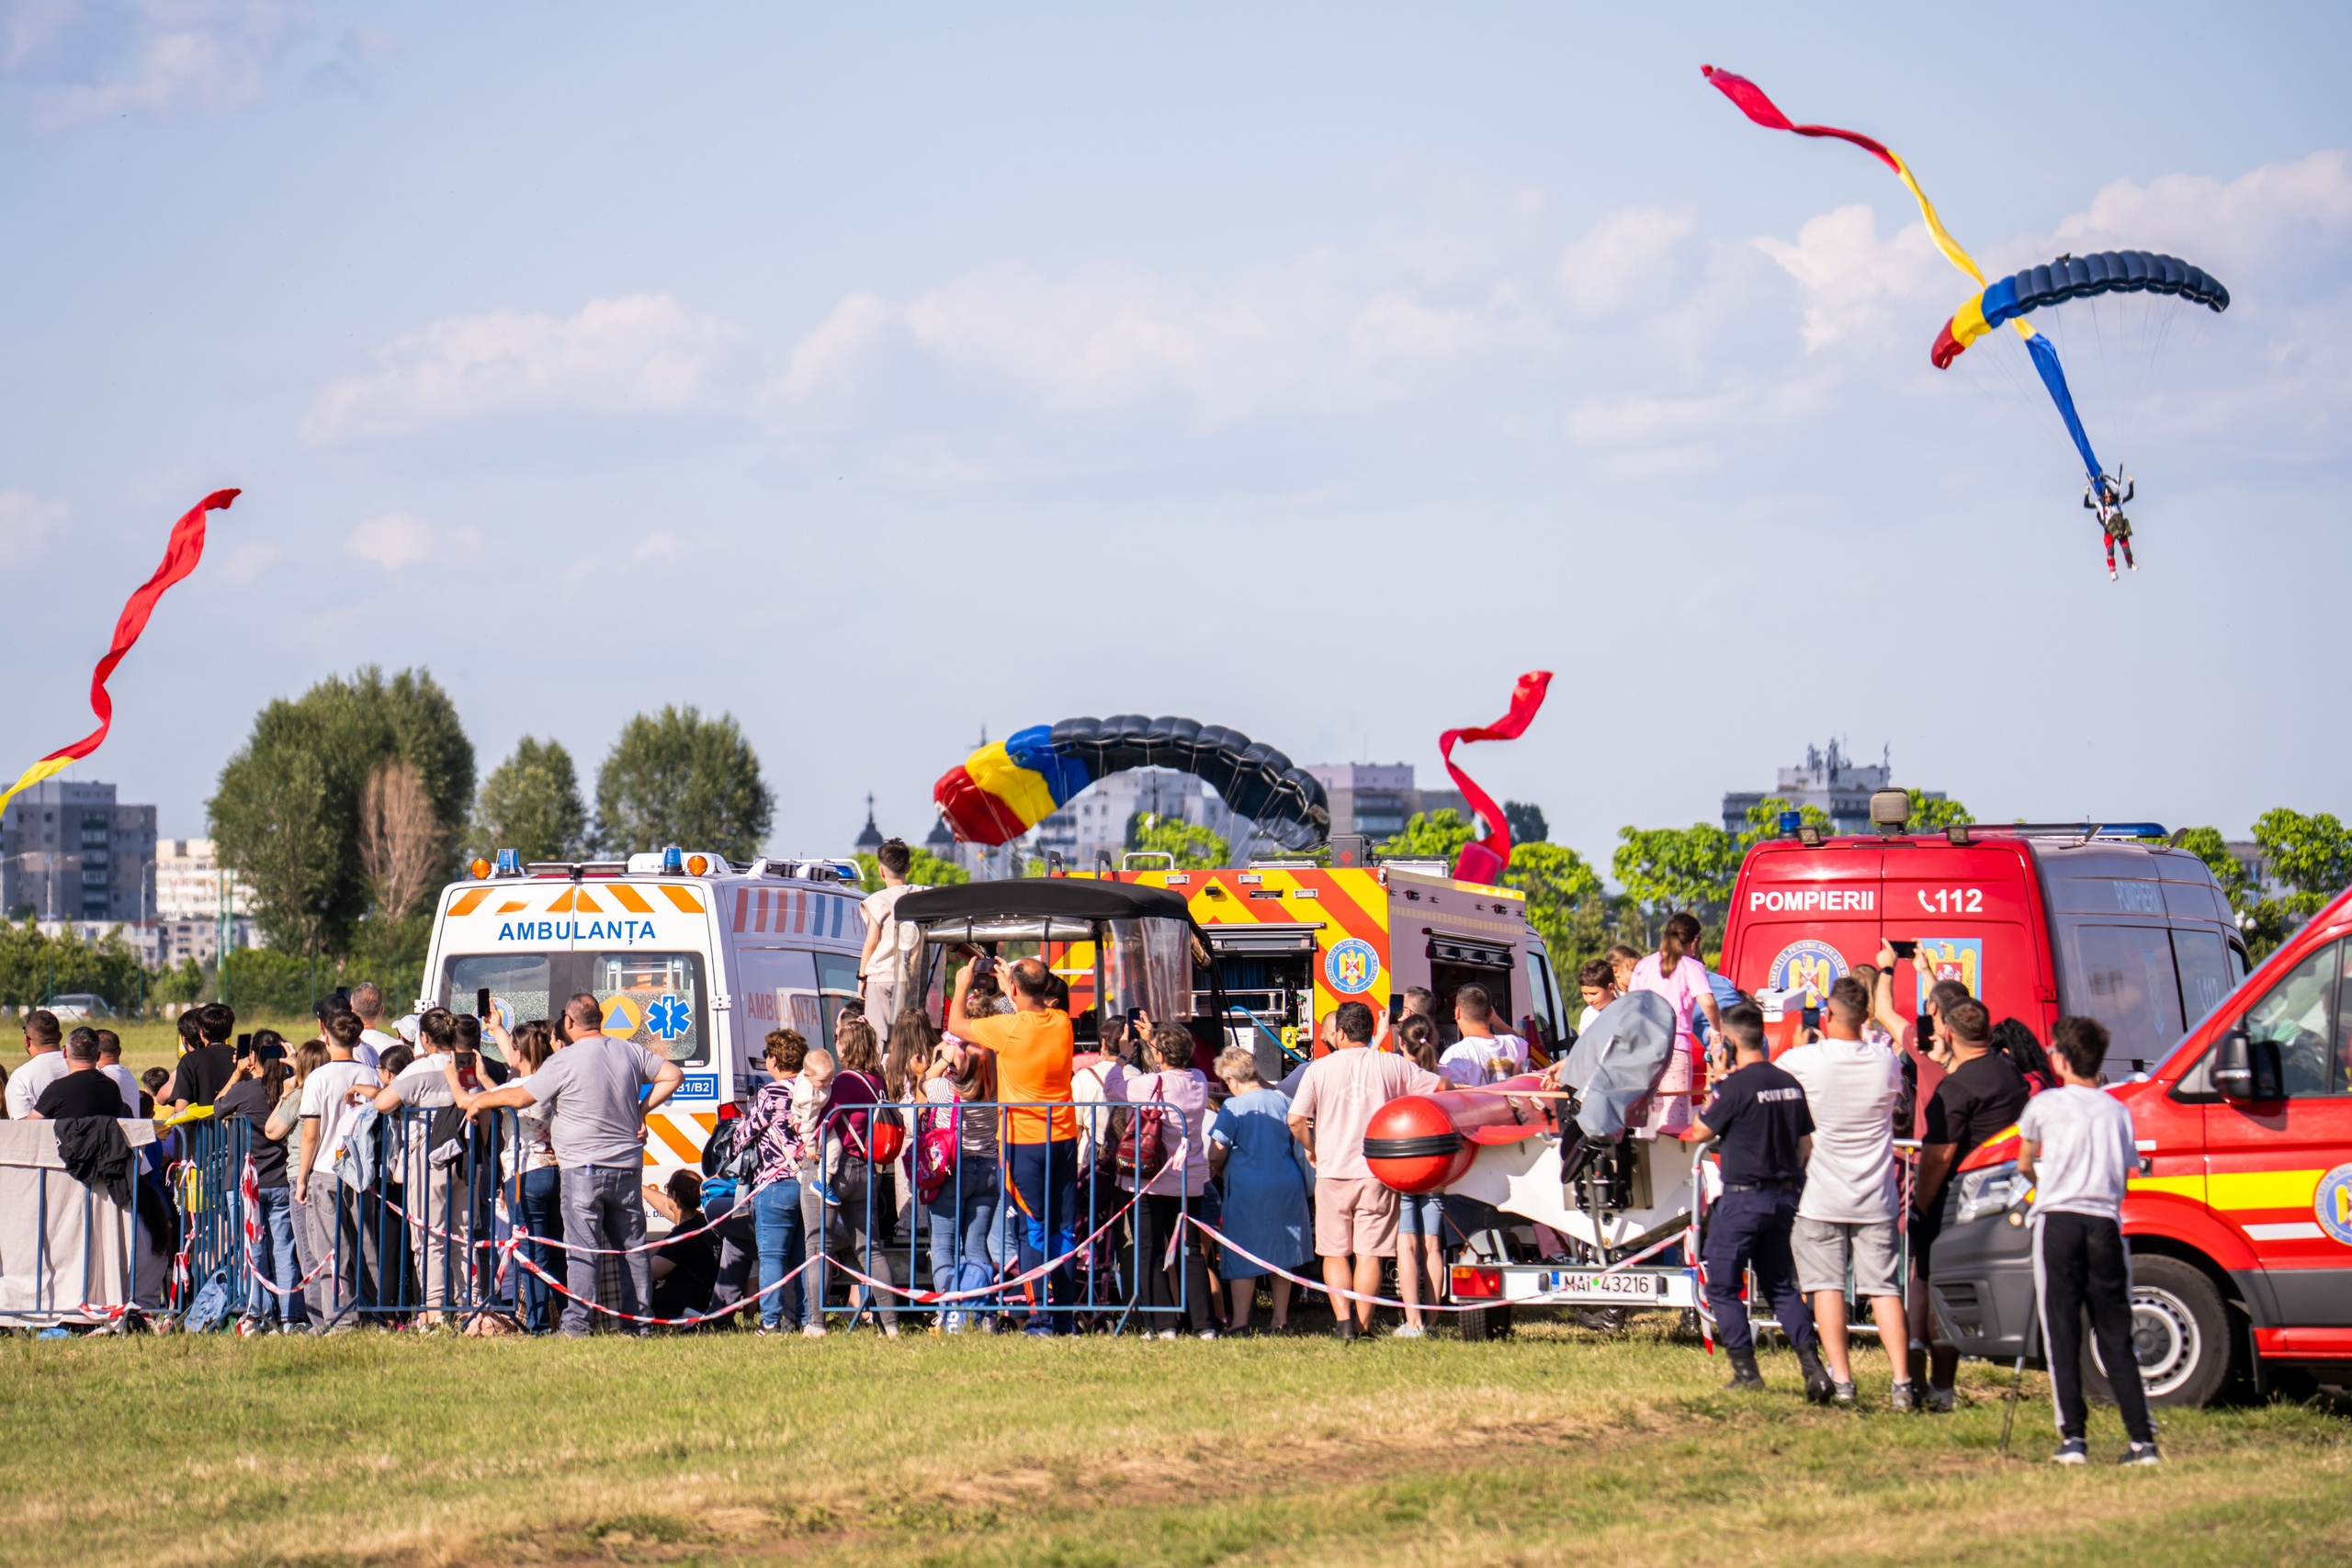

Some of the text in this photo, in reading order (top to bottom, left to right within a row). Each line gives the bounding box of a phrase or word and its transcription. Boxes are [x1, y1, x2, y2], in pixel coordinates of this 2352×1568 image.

[1750, 891, 1873, 911] POMPIERII
[1935, 889, 1983, 912] 112
[498, 920, 656, 945] AMBULANȚA
[677, 1082, 709, 1093] B1/B2
[1601, 1276, 1649, 1292] 43216
